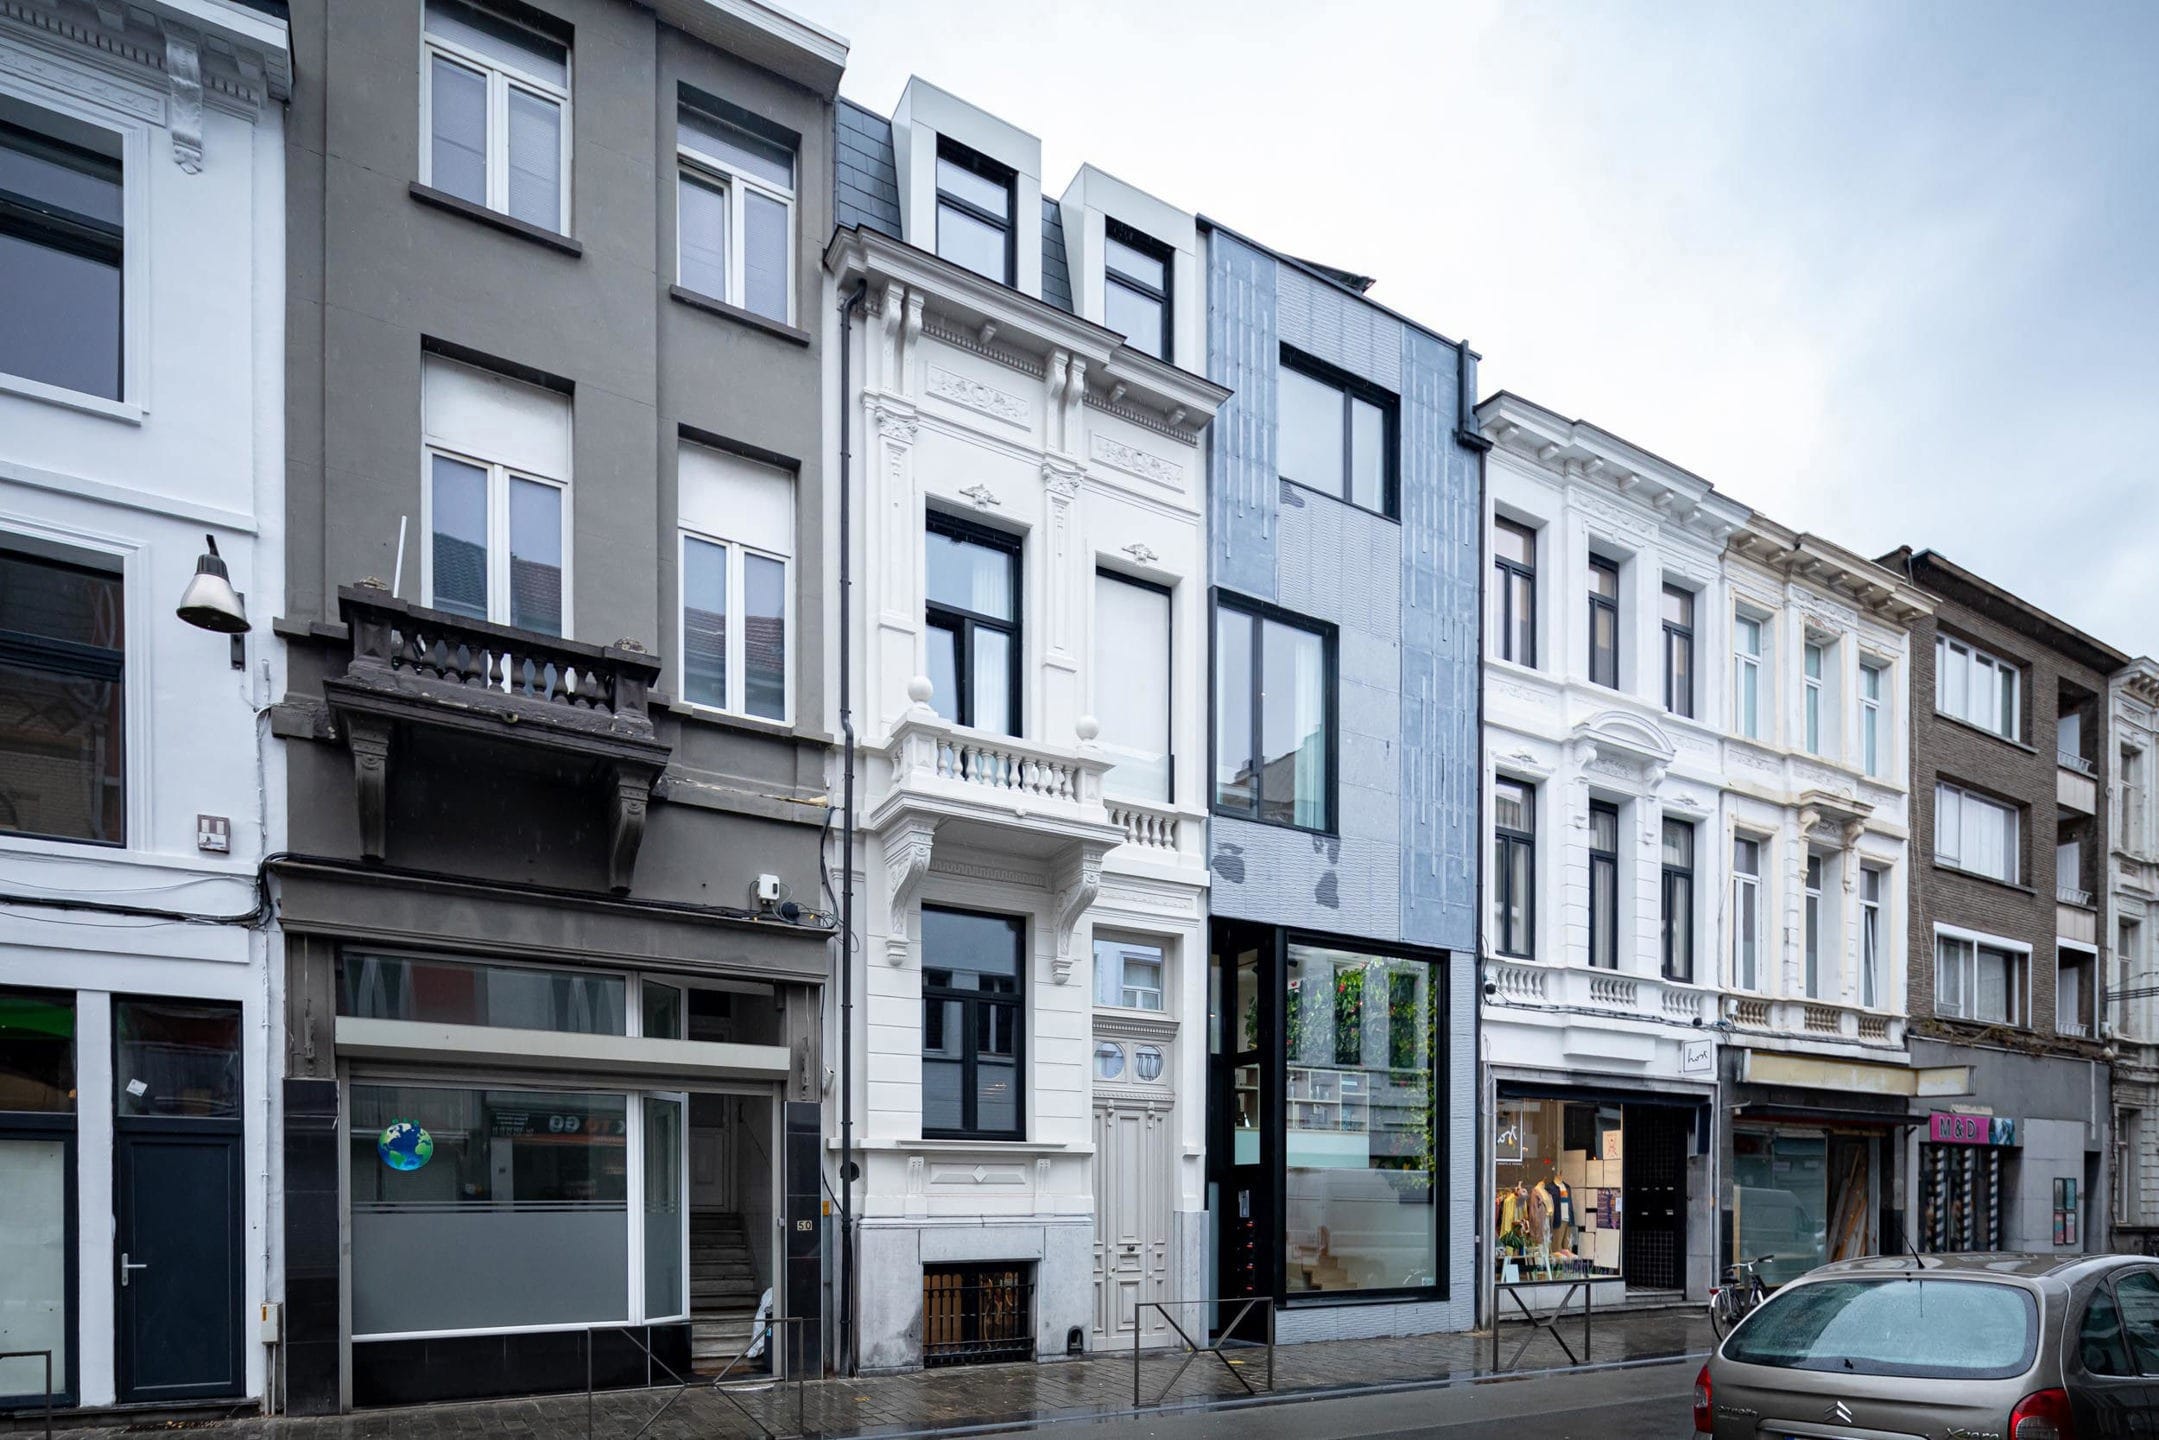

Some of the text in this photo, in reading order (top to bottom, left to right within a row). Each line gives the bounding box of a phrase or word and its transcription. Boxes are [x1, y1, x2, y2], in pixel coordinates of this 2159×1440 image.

[1939, 1116, 1977, 1139] M & D
[798, 1221, 811, 1230] 50
